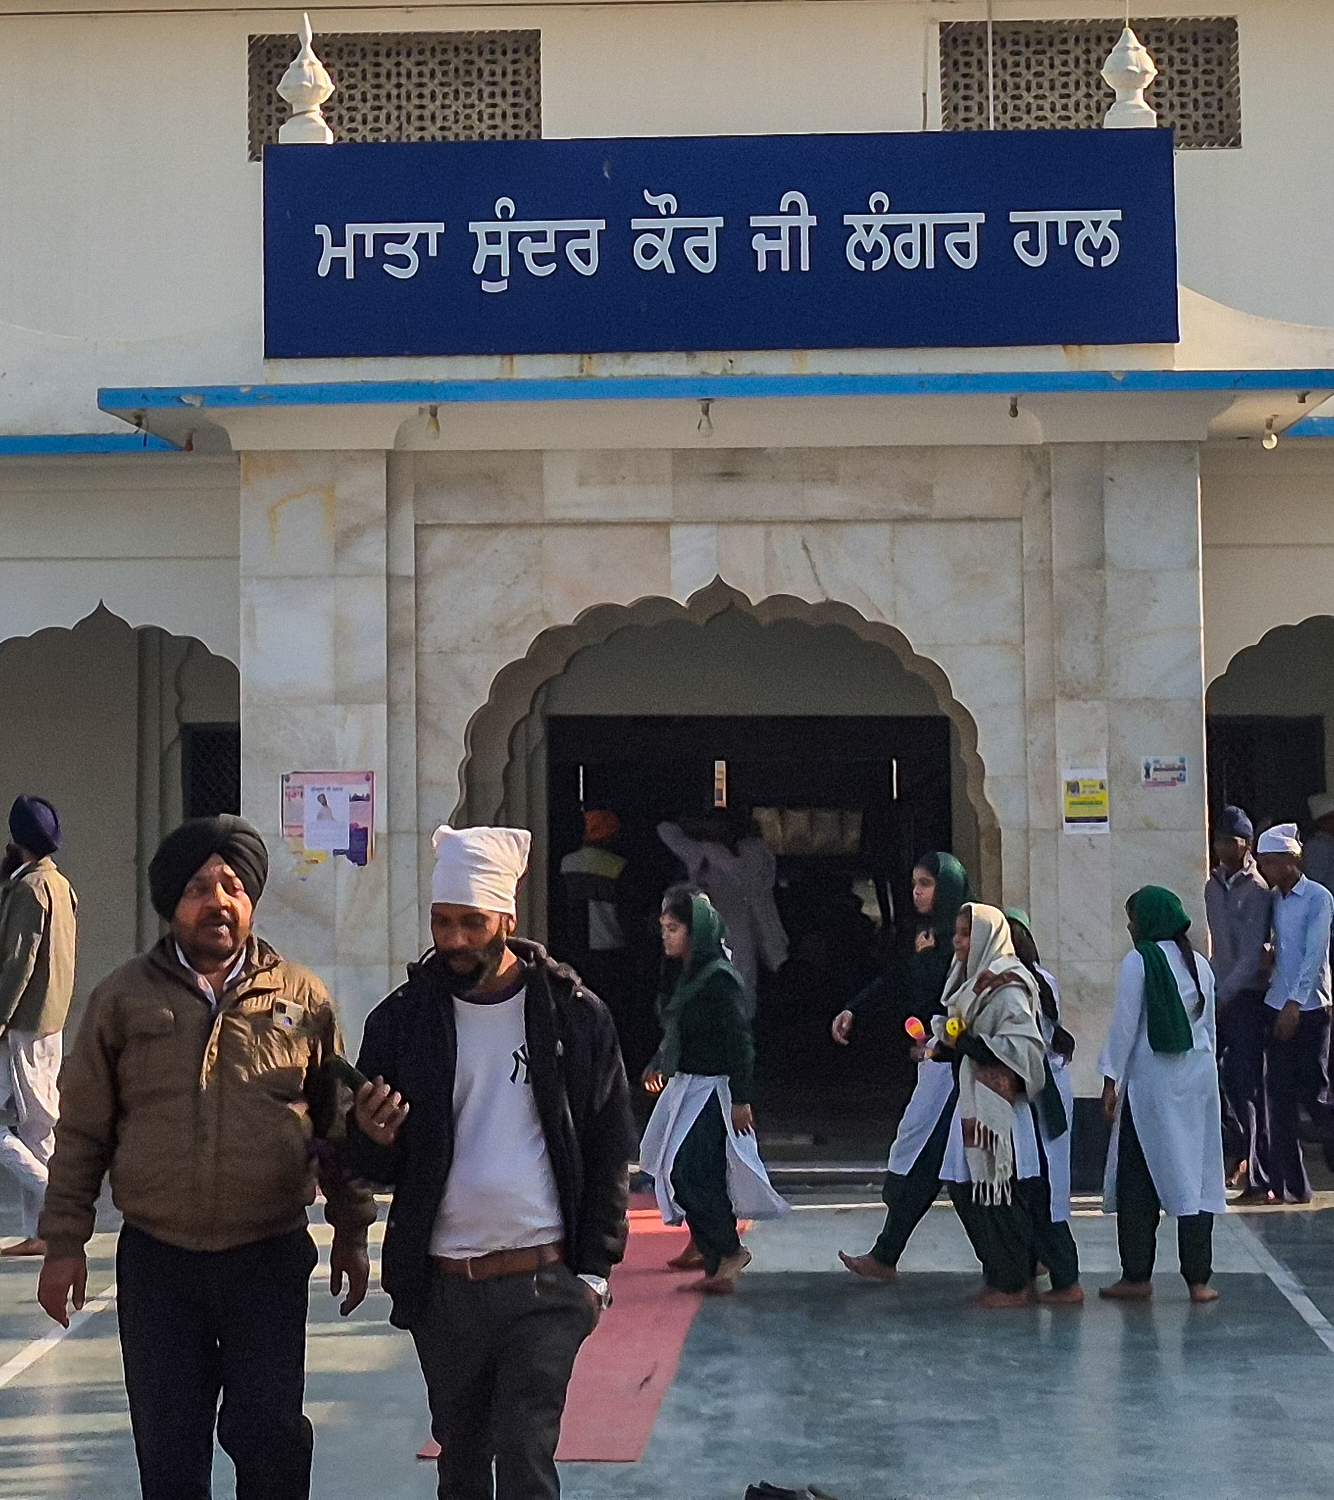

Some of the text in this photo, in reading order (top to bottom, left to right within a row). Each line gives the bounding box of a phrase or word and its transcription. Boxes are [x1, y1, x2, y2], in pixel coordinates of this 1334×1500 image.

[314, 188, 1123, 293] ਮਾਤਾ ਸੁੰਦਰ ਕੌਰ ਜੀ ਲੰਗਰ ਹਾਲ
